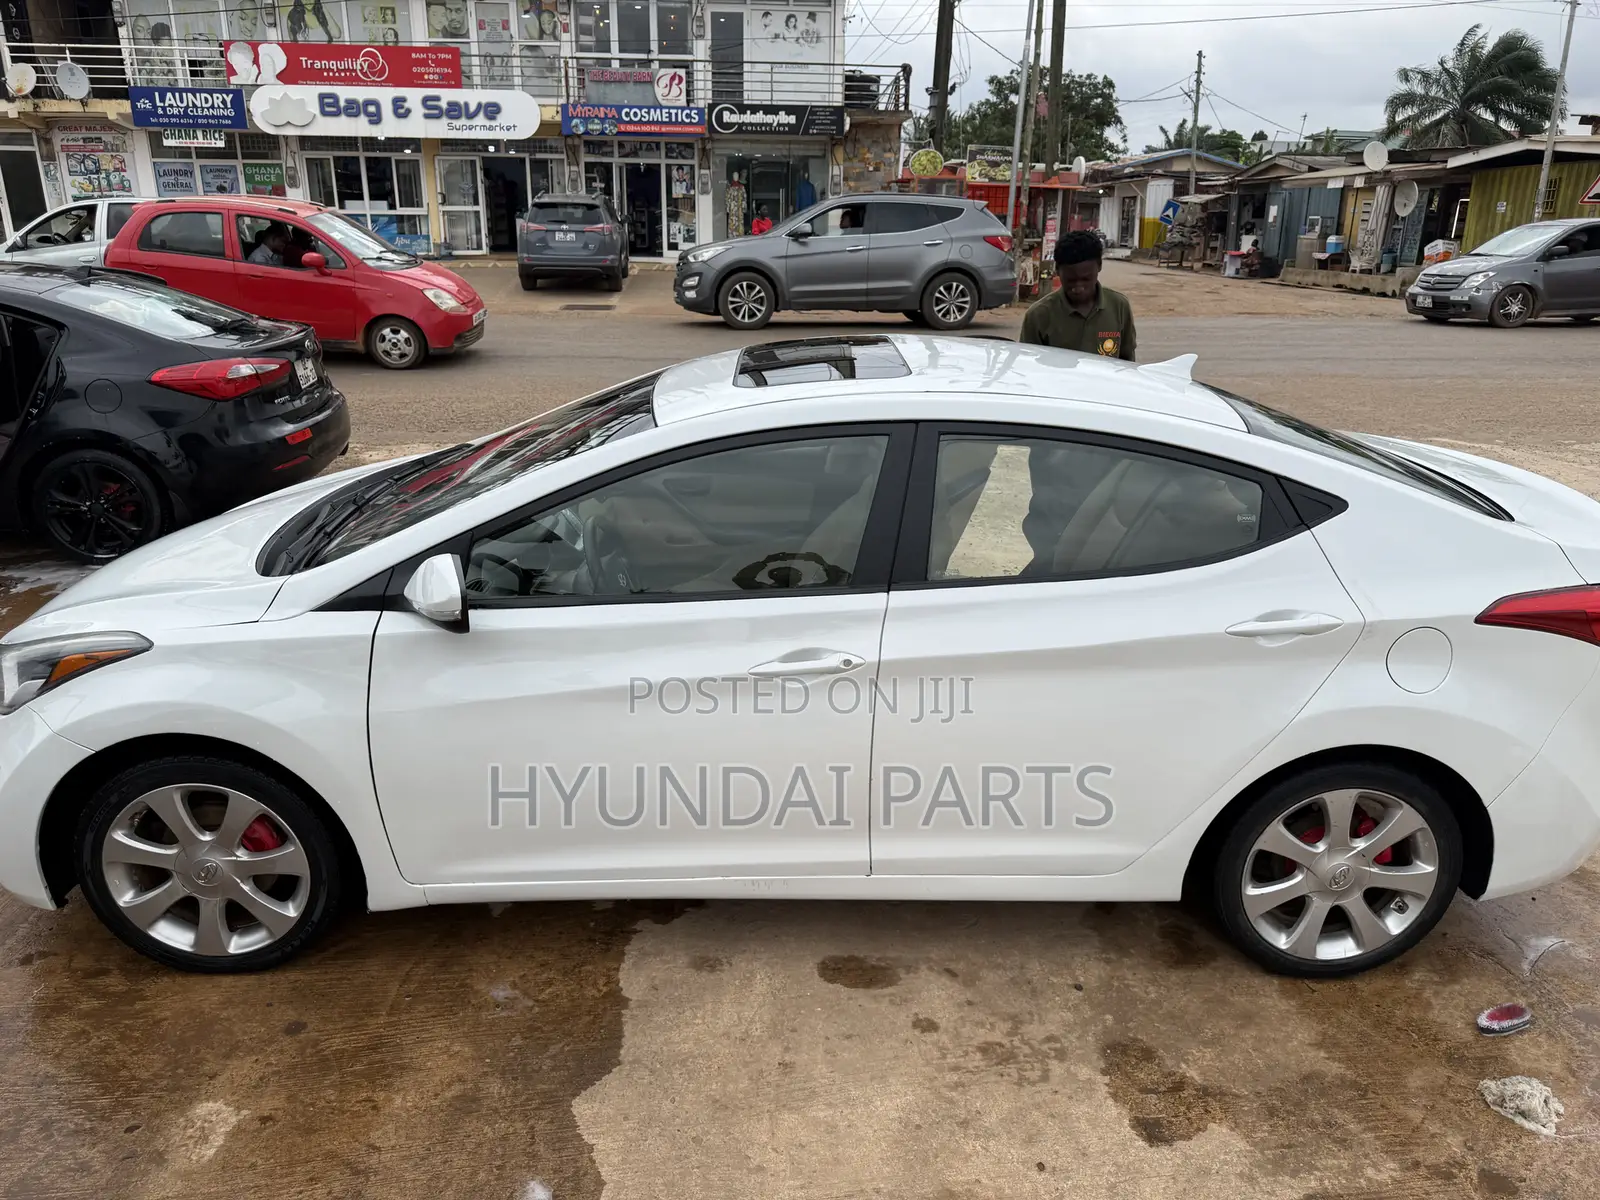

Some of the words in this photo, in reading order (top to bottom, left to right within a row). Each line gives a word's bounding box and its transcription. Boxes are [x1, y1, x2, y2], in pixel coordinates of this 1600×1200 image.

[299, 57, 369, 72] Tranquility
[588, 70, 603, 81] THE
[603, 70, 631, 82] BEAUTY
[632, 71, 653, 82] BARN
[154, 91, 234, 109] LAUNDRY
[157, 107, 164, 115] &
[166, 107, 185, 115] DRY
[187, 107, 236, 117] CLEANING
[318, 92, 383, 125] Bag
[392, 95, 412, 119] &
[421, 95, 502, 121] Save
[568, 104, 619, 119] MYRAINA
[621, 107, 699, 123] COSMETICS
[722, 110, 797, 127] Raudathayiba
[446, 122, 518, 133] Supermarket
[162, 128, 200, 141] GHANA
[202, 129, 225, 141] RICE
[157, 168, 194, 179] LAUNDRY
[245, 166, 282, 174] GHANA
[254, 174, 277, 182] RICE
[162, 181, 193, 189] GENERAL
